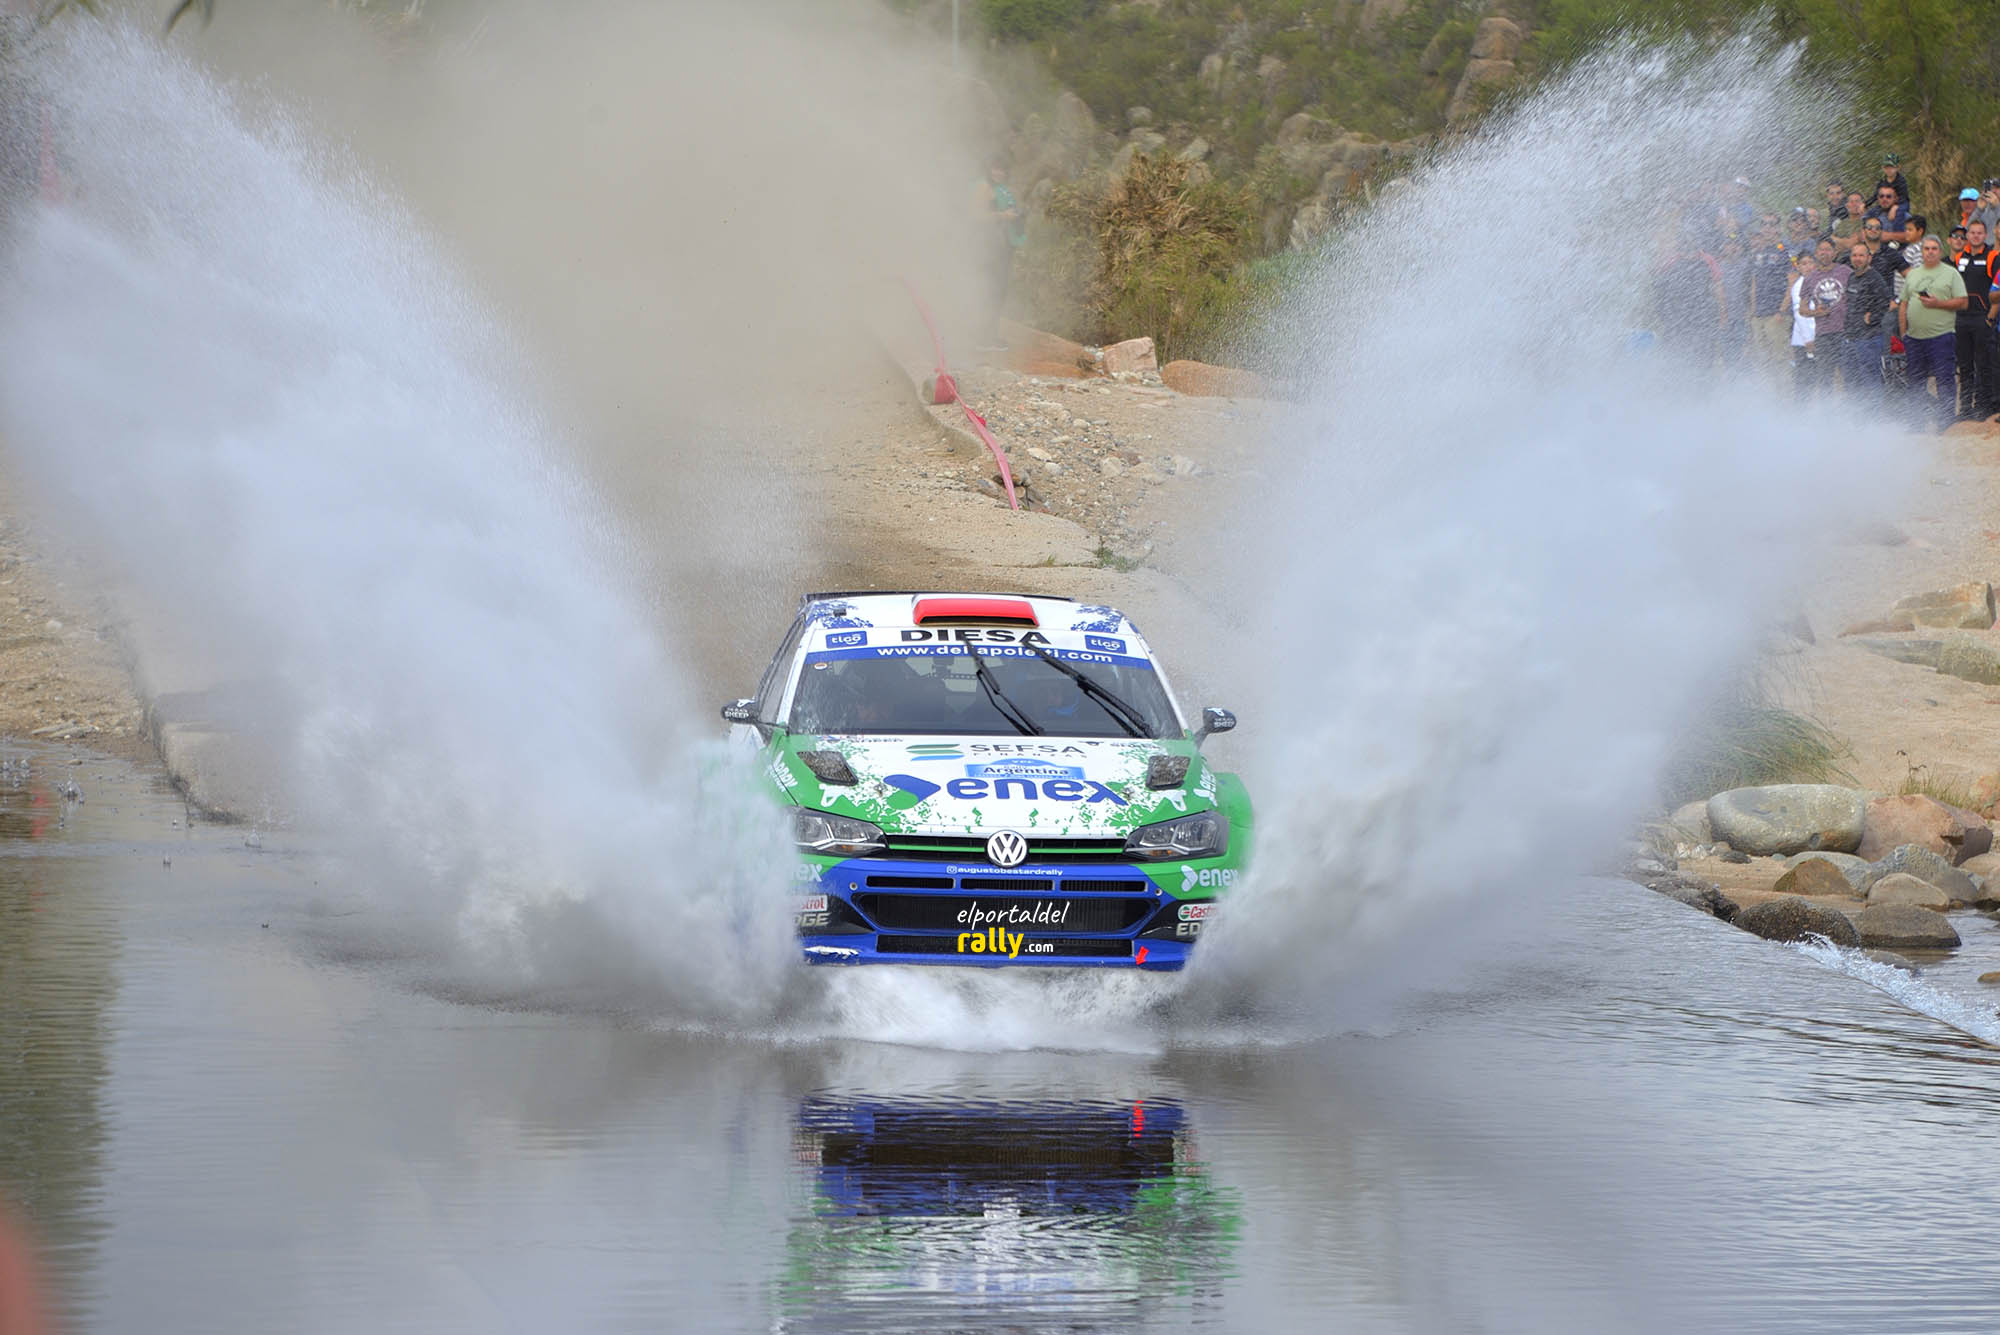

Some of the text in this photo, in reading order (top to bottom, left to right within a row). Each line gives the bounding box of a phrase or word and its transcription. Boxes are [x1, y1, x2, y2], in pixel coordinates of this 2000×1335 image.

[831, 633, 861, 645] tigo
[901, 629, 1051, 644] DIESA
[1091, 638, 1120, 651] tigo
[877, 645, 1112, 663] www.delapoleti.com
[970, 744, 1085, 754] SEFSA
[984, 766, 1069, 777] Argentina
[947, 778, 1128, 806] enex
[958, 868, 1063, 876] augustobestardrally
